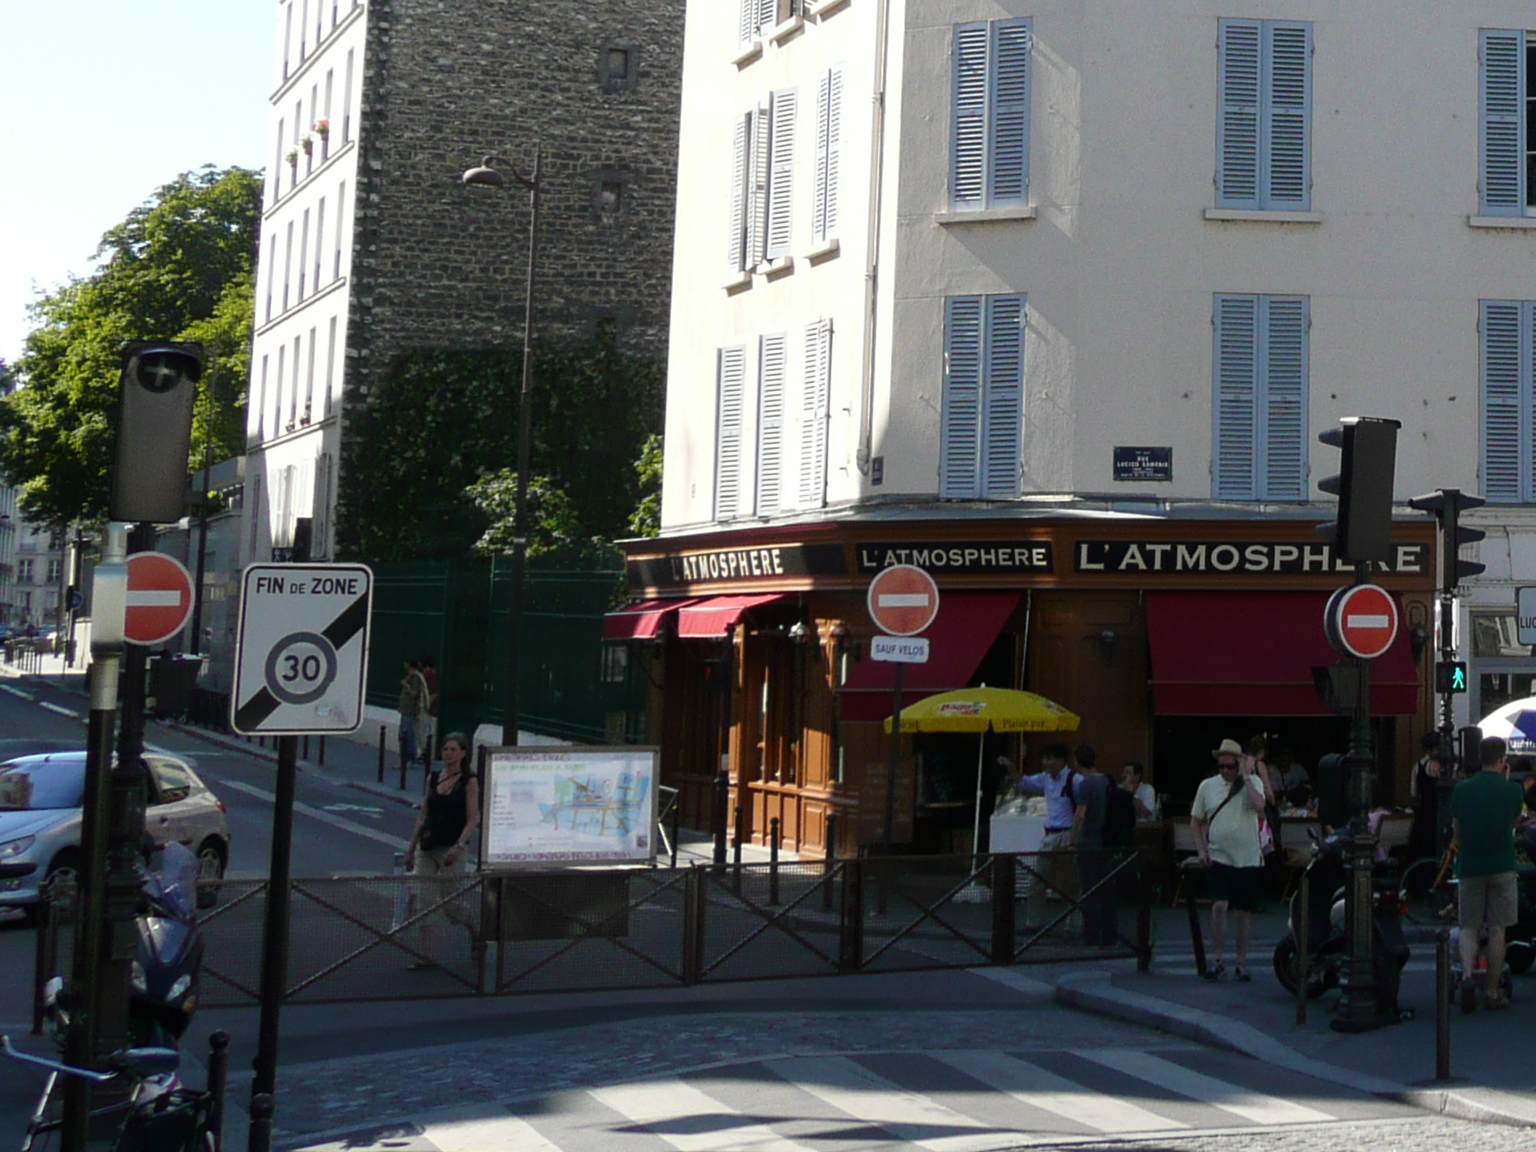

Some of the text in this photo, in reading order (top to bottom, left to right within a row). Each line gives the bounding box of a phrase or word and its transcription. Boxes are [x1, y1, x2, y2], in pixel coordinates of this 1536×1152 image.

[1079, 543, 1421, 571] L'ATMOSPHE
[256, 577, 358, 594] FIN DE ZONE
[875, 644, 896, 654] SAUF
[282, 655, 320, 682] 30
